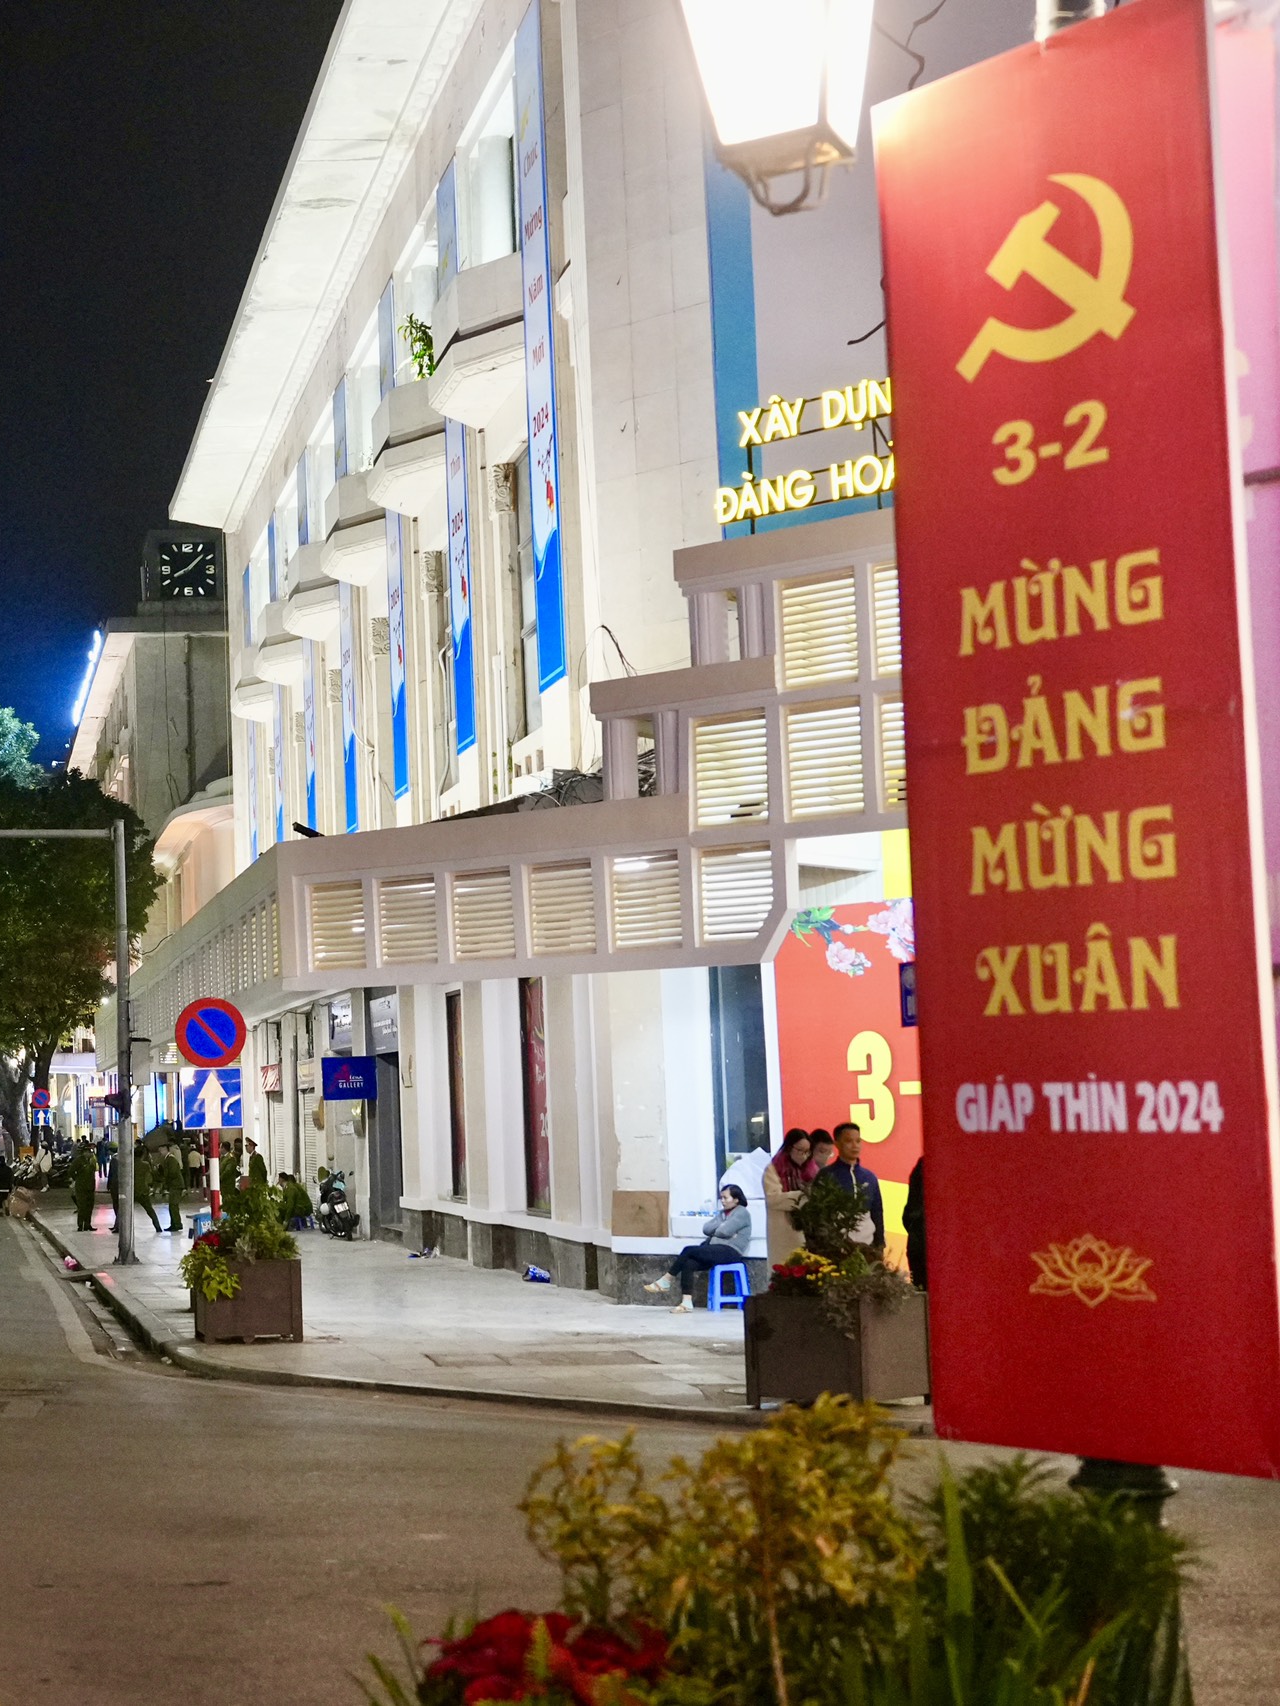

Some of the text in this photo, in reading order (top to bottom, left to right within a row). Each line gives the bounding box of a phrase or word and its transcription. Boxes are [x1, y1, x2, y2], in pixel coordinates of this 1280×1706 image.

[532, 402, 549, 440] 2024
[738, 394, 805, 447] XÂY
[991, 399, 1111, 487] 3-2
[451, 508, 464, 538] 2024
[714, 470, 817, 524] ĐÀNG
[162, 565, 215, 575] 9 3
[182, 544, 193, 553] 12
[184, 587, 194, 596] 6
[958, 547, 1165, 657] MỪNG
[961, 675, 1167, 775] ĐẢNG
[970, 802, 1178, 896] MỪNG
[976, 922, 1180, 1017] XUÂN
[338, 1081, 364, 1089] GALLERY
[955, 1072, 1224, 1134] GIÁP THÌN 2024
